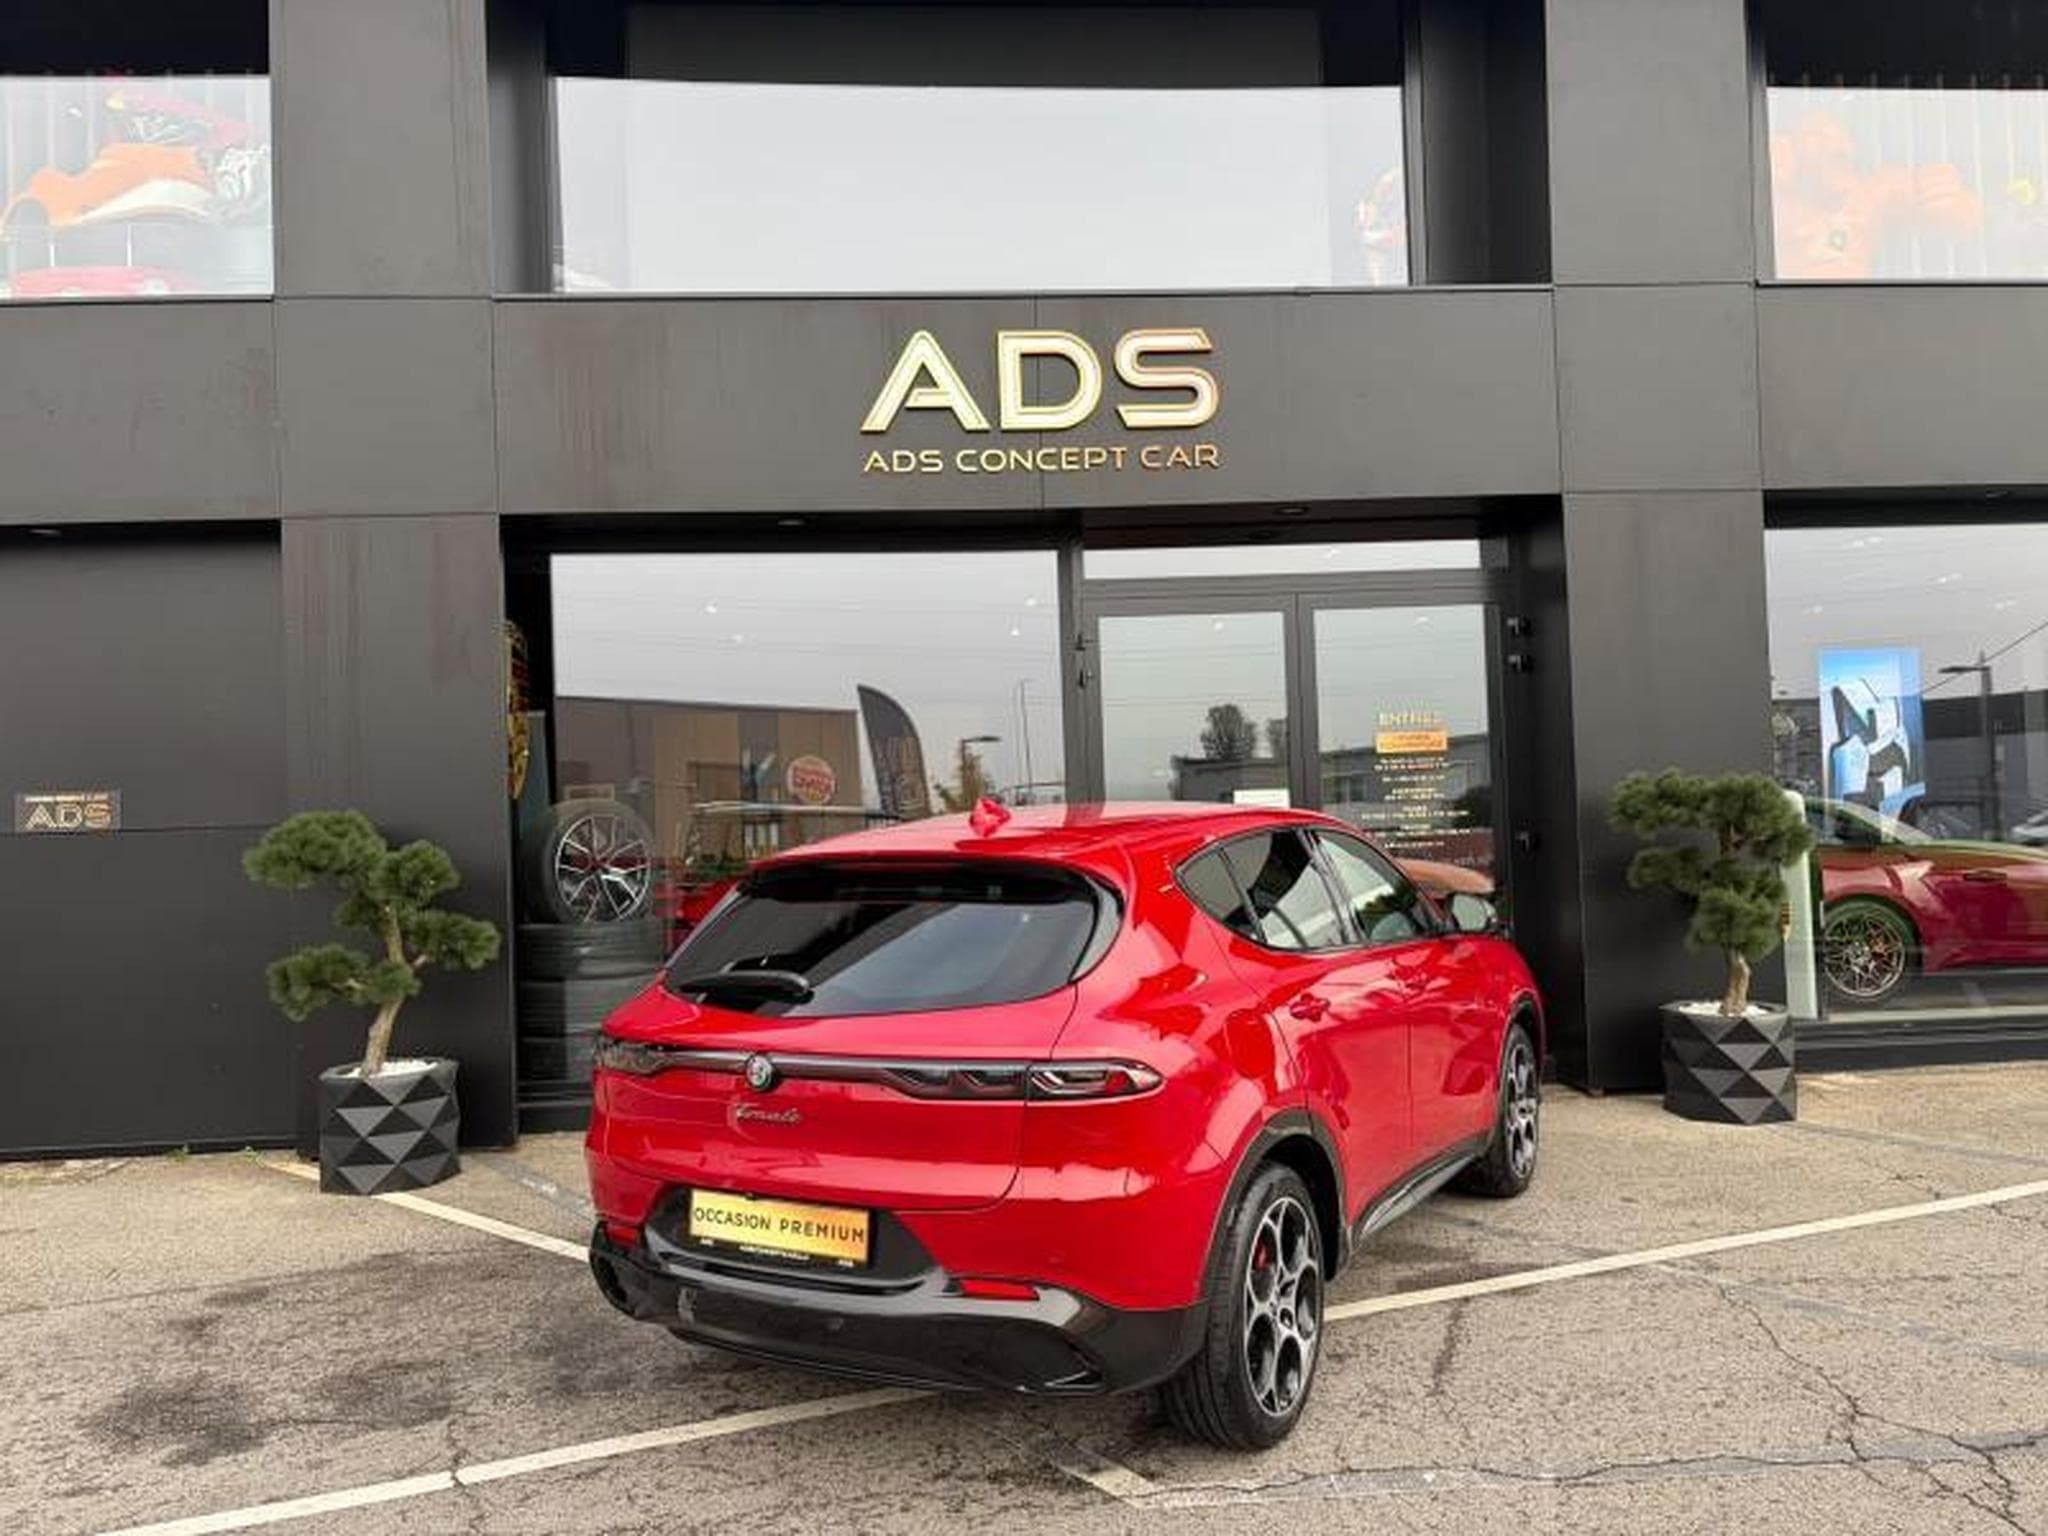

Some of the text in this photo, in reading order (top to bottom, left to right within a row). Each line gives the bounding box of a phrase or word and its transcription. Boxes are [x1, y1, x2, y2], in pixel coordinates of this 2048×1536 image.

[860, 327, 1220, 433] ADS
[864, 445, 1220, 473] ADS CONCEPT CAR
[25, 803, 112, 829] ADS
[695, 1206, 864, 1243] OCCASION PREMIUM
